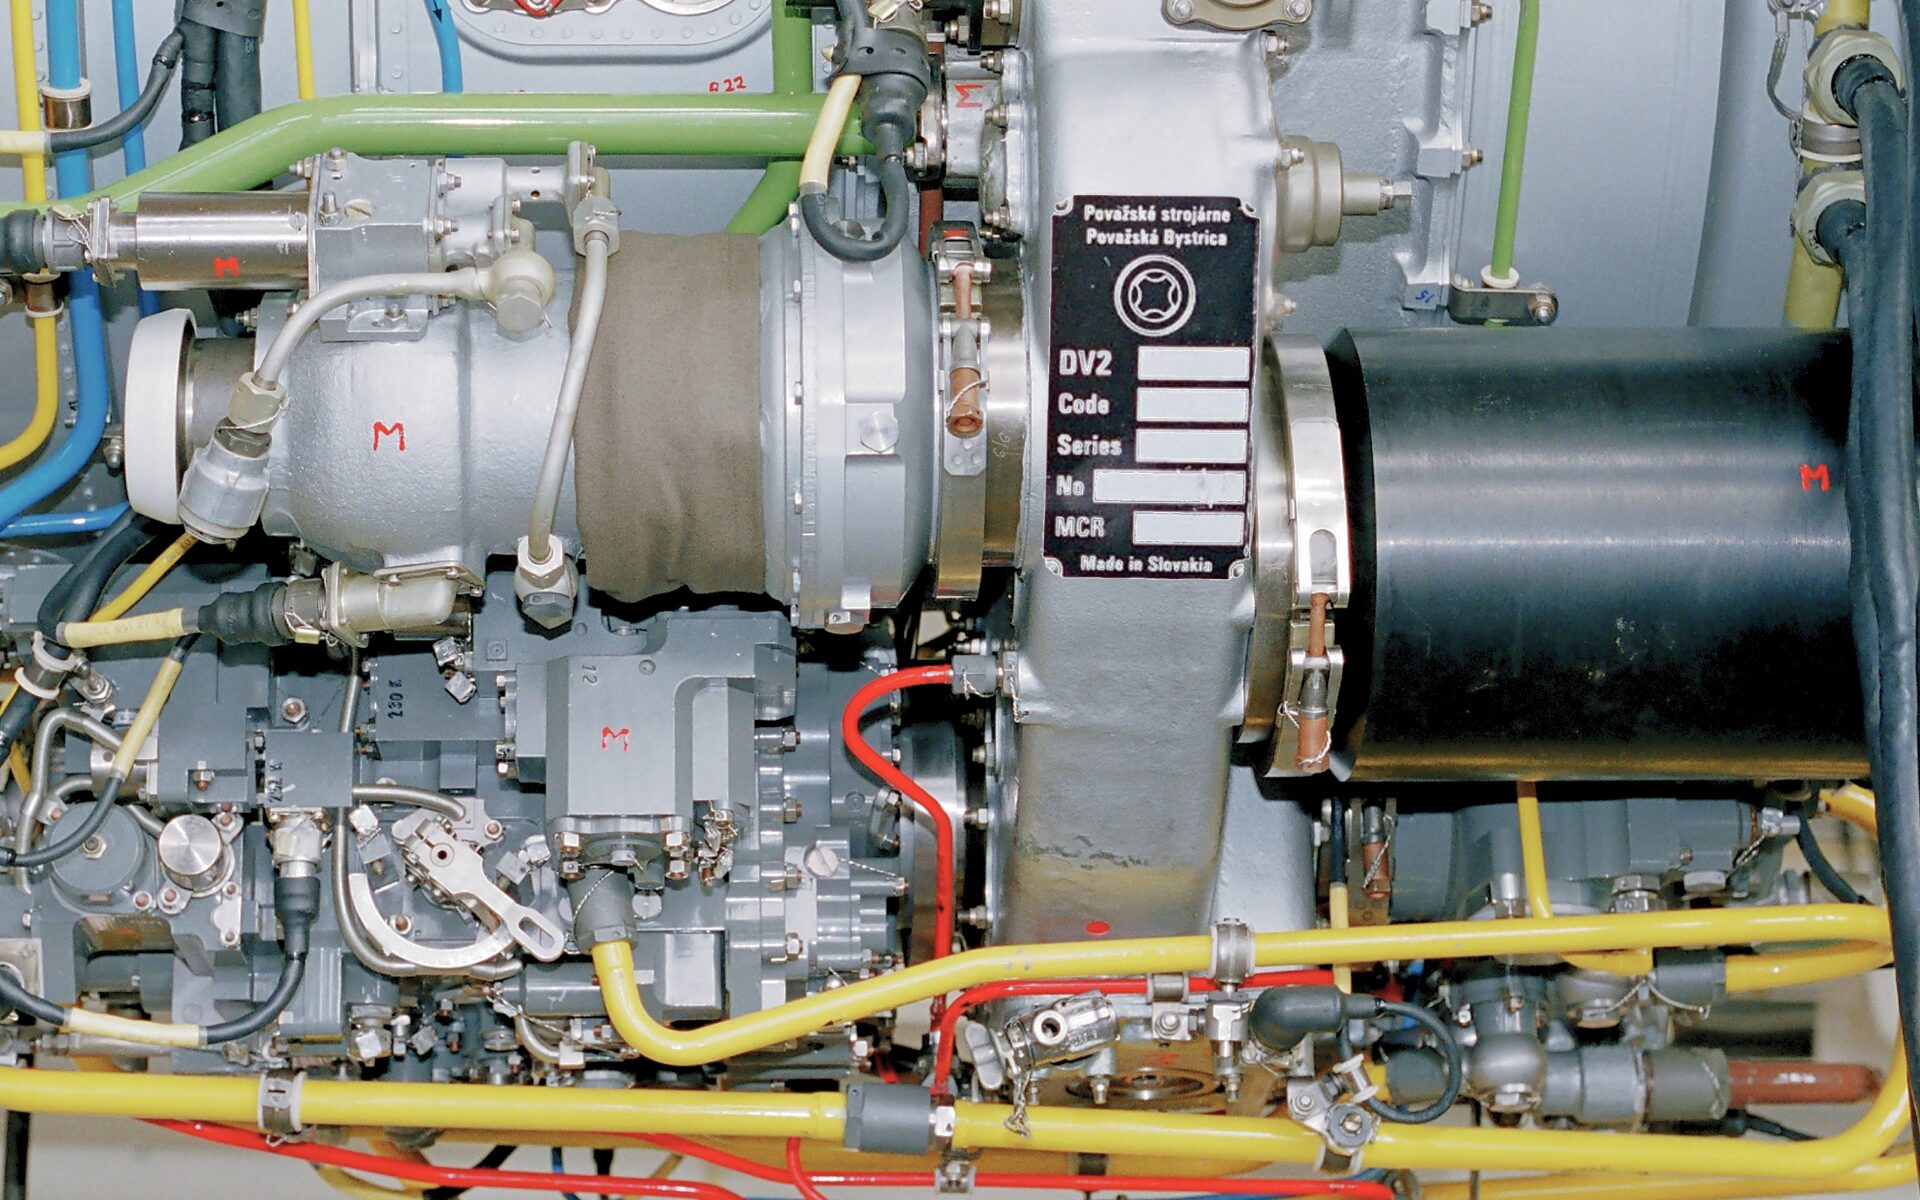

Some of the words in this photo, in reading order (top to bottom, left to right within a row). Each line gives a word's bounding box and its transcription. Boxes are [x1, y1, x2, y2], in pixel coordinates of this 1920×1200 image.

[1161, 205, 1231, 225] strojárne
[1086, 228, 1159, 245] Považská
[1163, 229, 1228, 248] Bystrica
[214, 257, 239, 278] M
[1059, 349, 1112, 376] DV2
[1058, 393, 1110, 415] Code
[373, 420, 406, 451] M
[1056, 434, 1122, 456] Series
[1056, 475, 1085, 496] No
[1801, 463, 1830, 491] M
[1054, 516, 1105, 537] MCR
[1080, 555, 1123, 571] Made
[1128, 556, 1142, 571] in
[1148, 556, 1213, 572] Slovakia
[602, 727, 630, 752] M
